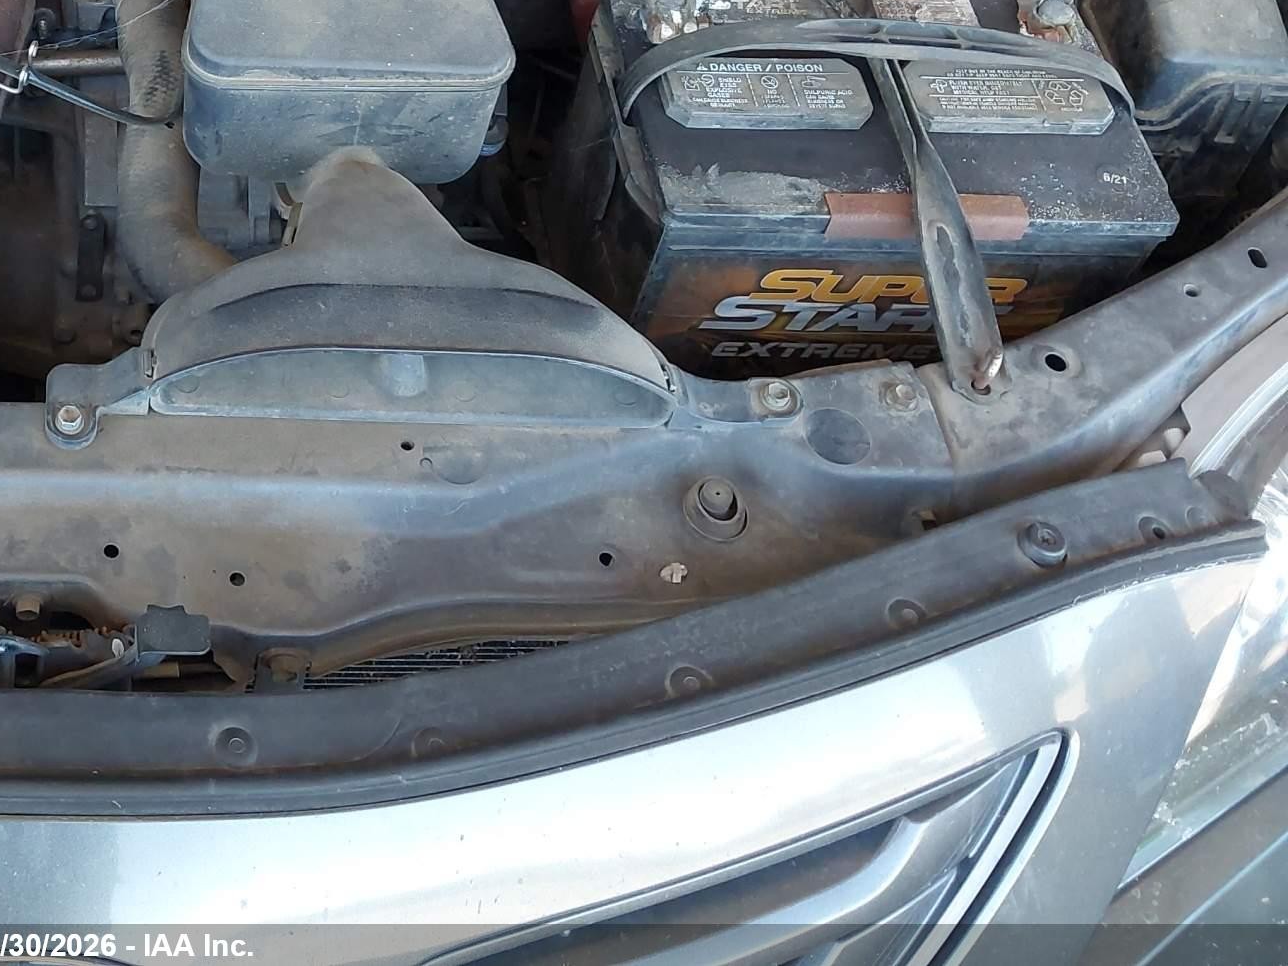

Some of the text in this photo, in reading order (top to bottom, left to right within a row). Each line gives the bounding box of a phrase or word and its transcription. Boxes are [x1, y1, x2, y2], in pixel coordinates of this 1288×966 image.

[709, 63, 823, 72] DANGER / POISON
[1103, 172, 1127, 184] 6/21
[748, 268, 1028, 304] SUPR
[711, 341, 939, 360] EXTREME
